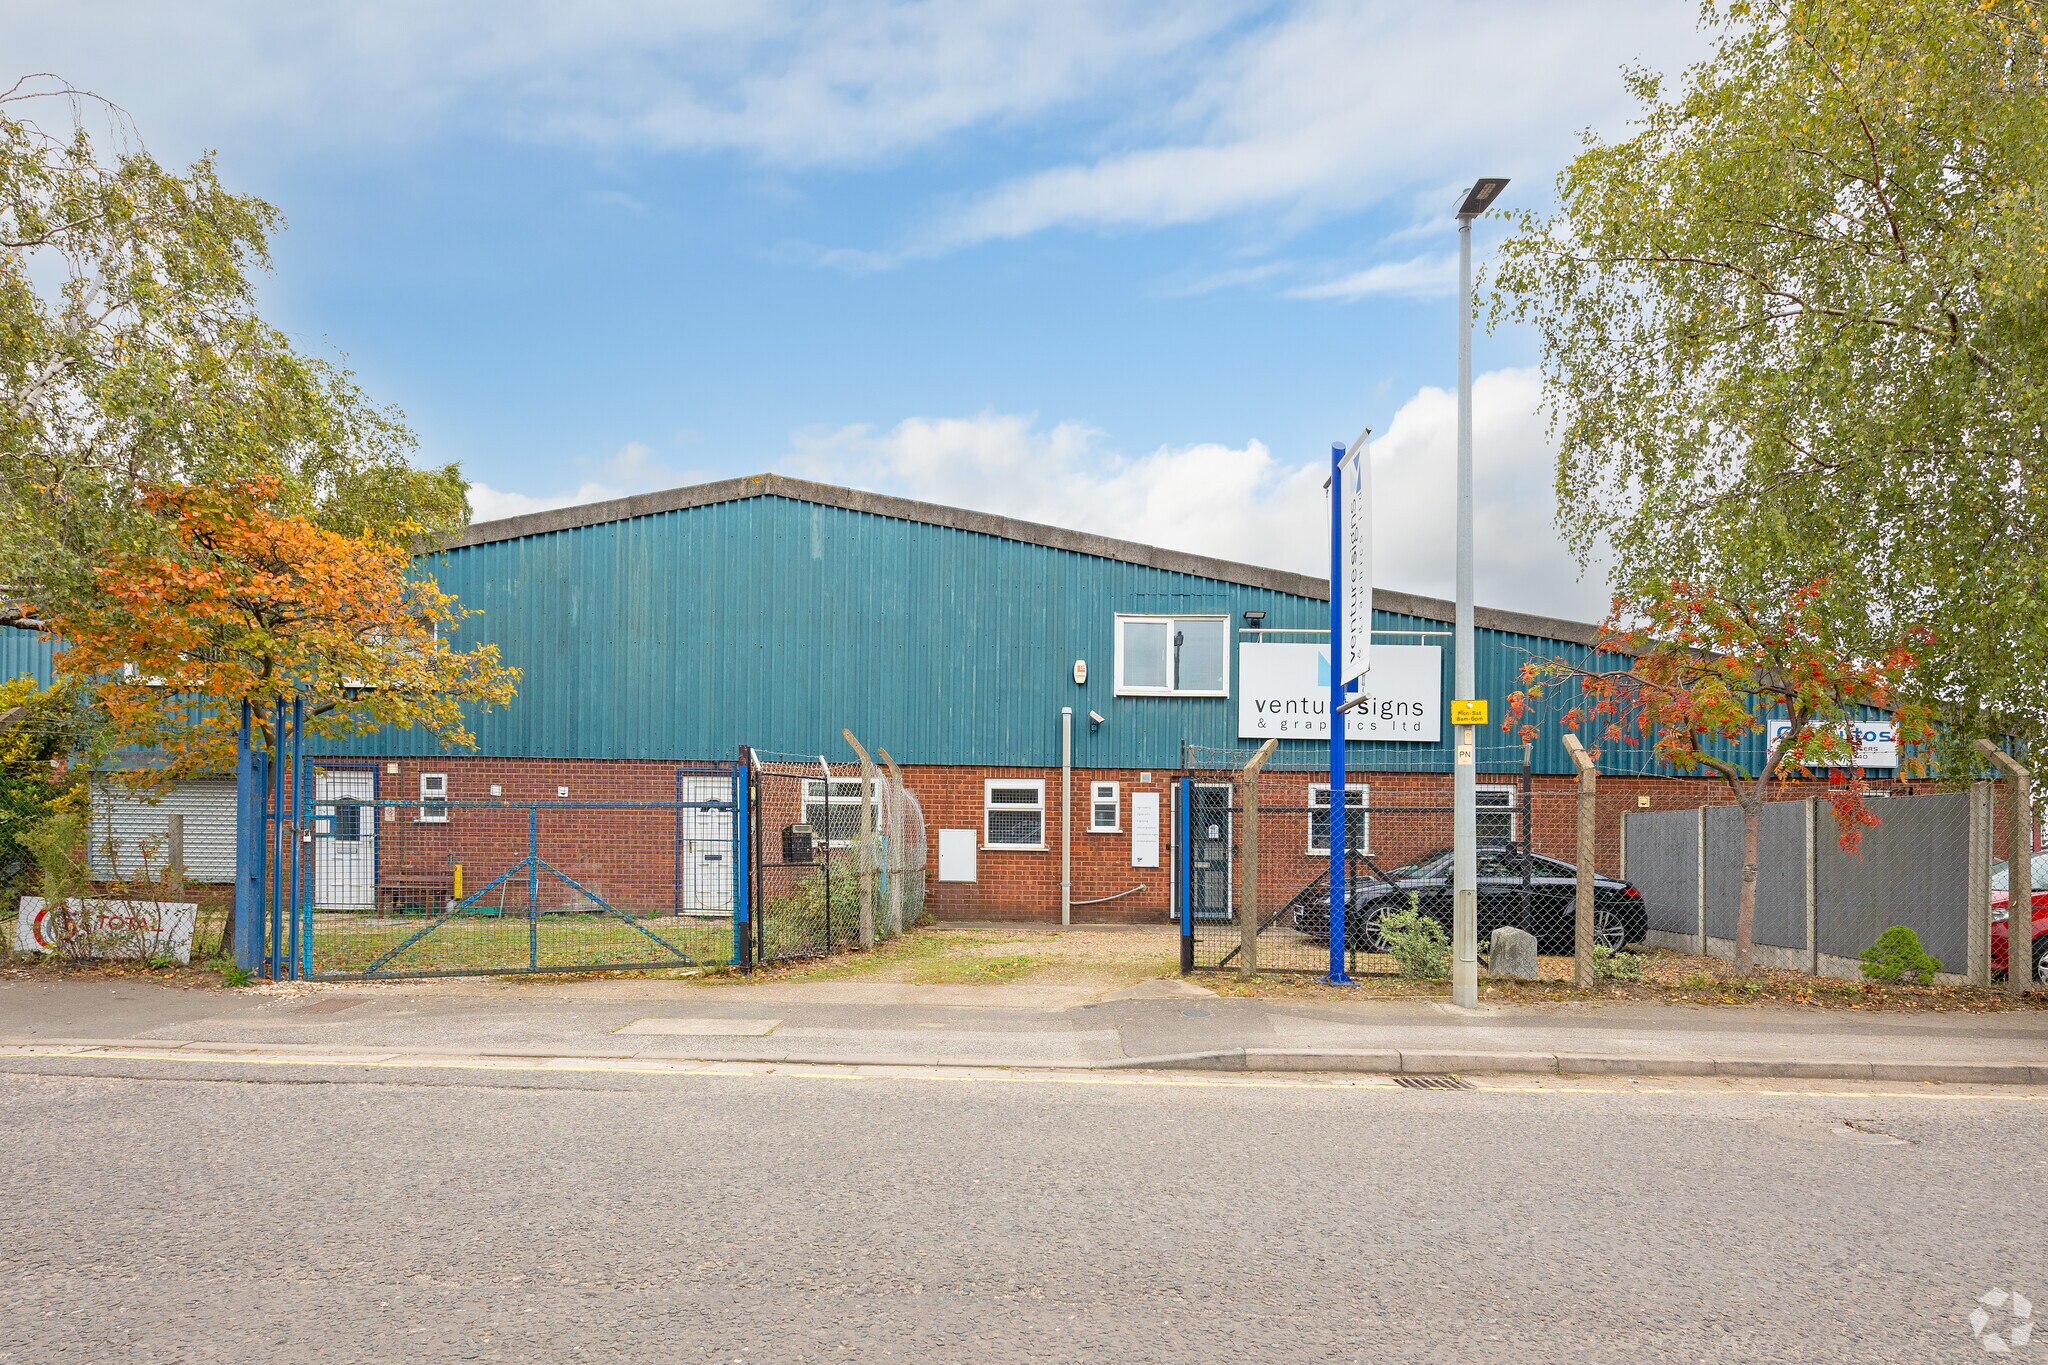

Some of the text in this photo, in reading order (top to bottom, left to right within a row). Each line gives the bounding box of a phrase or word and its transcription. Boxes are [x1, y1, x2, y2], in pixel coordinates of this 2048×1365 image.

[1255, 697, 1424, 720] ventusigns
[1257, 718, 1422, 732] & grapics ltd
[96, 914, 164, 933] TOTAL
